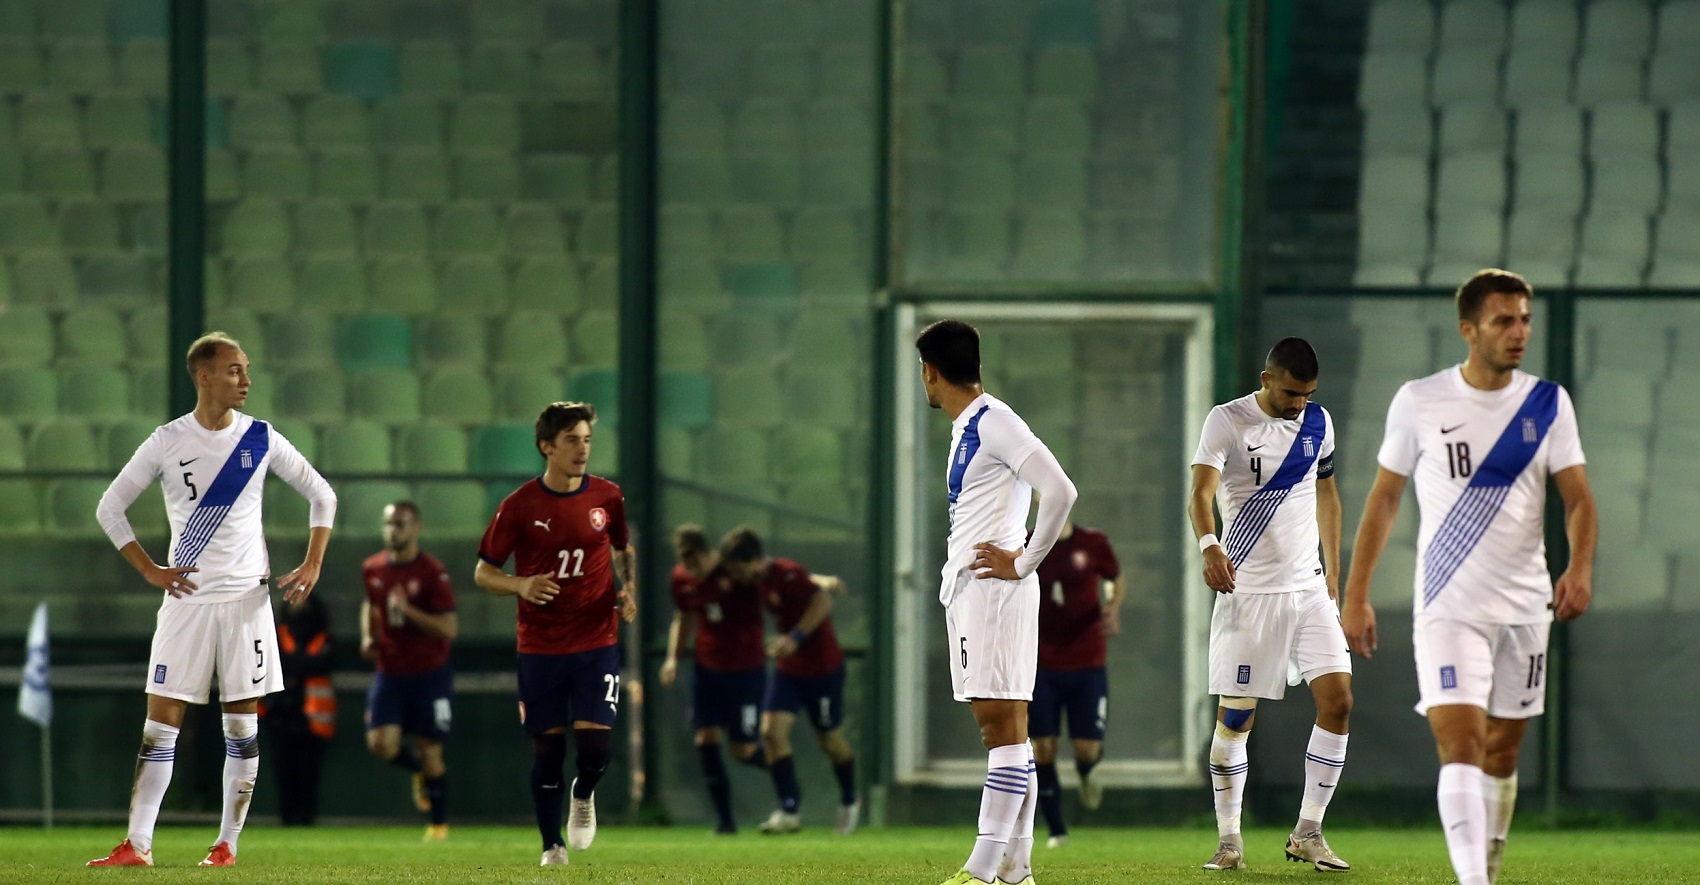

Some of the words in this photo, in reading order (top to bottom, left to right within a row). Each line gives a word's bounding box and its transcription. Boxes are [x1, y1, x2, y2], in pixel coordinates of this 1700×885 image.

[1251, 457, 1262, 486] 4
[1446, 442, 1472, 479] 18
[184, 471, 197, 501] 5
[558, 549, 585, 578] 22
[254, 639, 264, 669] 5
[960, 636, 968, 669] 6
